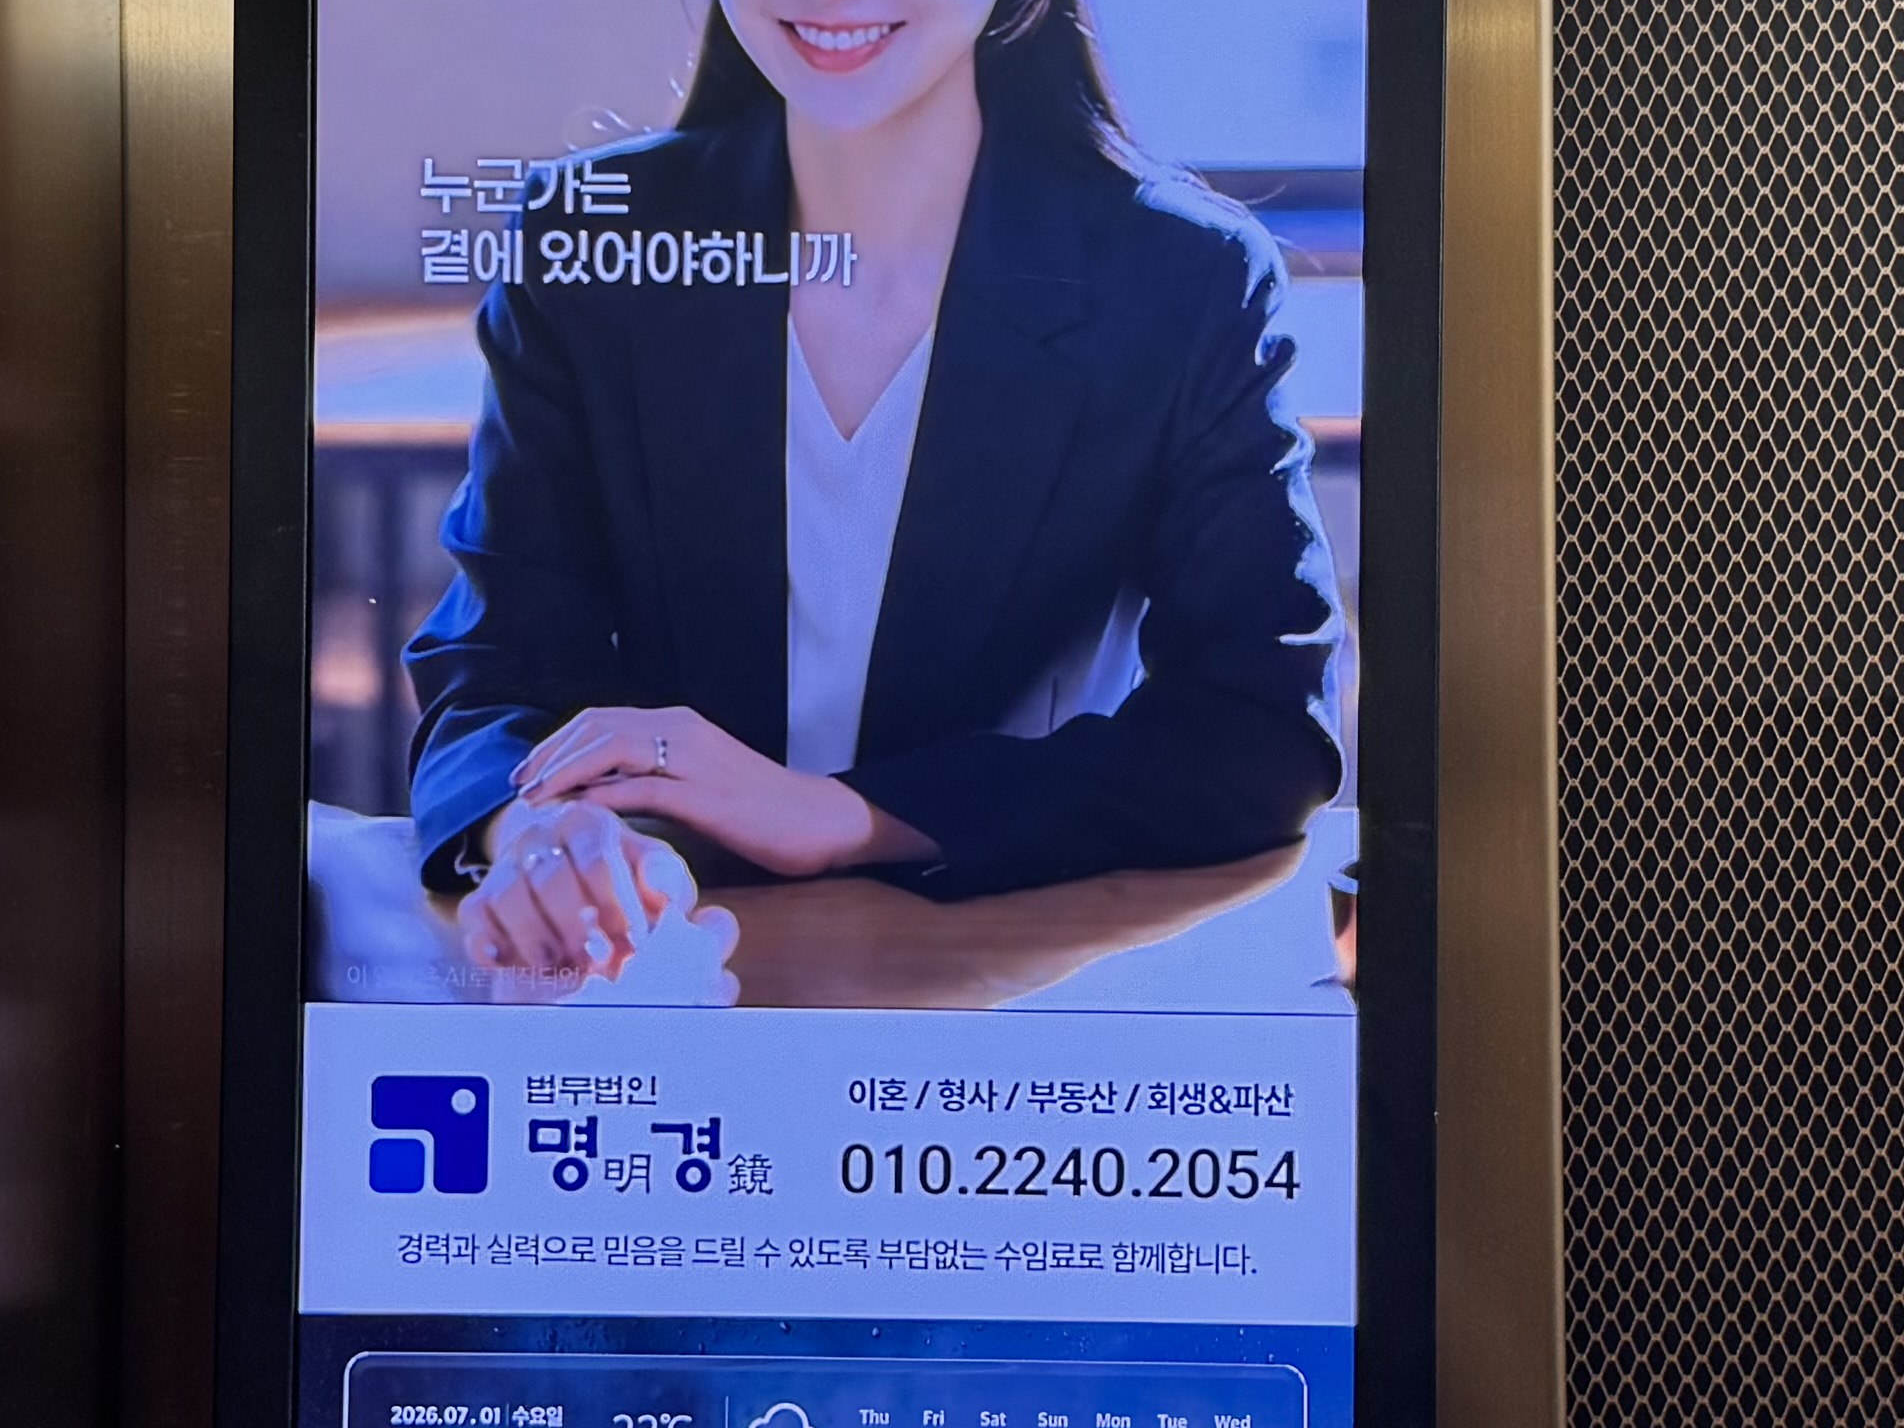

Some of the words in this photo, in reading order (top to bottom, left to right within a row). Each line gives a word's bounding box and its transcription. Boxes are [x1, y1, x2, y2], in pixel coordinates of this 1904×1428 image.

[420, 157, 632, 214] 누군가는
[420, 229, 527, 286] 곁에
[540, 229, 858, 288] 있어야하니까
[525, 1074, 658, 1107] 법무법인
[848, 1078, 909, 1113] 이혼
[937, 1079, 999, 1113] 형사
[1026, 1080, 1119, 1115] 부동산
[1147, 1082, 1297, 1117] 회생&파산
[839, 1143, 1302, 1201] 010.2240.2054
[396, 1234, 482, 1267] 경력과
[487, 1234, 598, 1267] 실력으로
[603, 1234, 687, 1269] 믿음을
[691, 1234, 746, 1270] 드릴
[753, 1236, 783, 1270] 수
[788, 1235, 872, 1271] 있도록
[875, 1237, 989, 1272] 부담없는
[993, 1238, 1106, 1273] 수임료로
[1111, 1240, 1259, 1277] 함께합니다.
[511, 1406, 565, 1428] 수요일
[857, 1406, 891, 1427] Thu
[920, 1407, 946, 1428] Fri
[977, 1408, 1008, 1428] Sat
